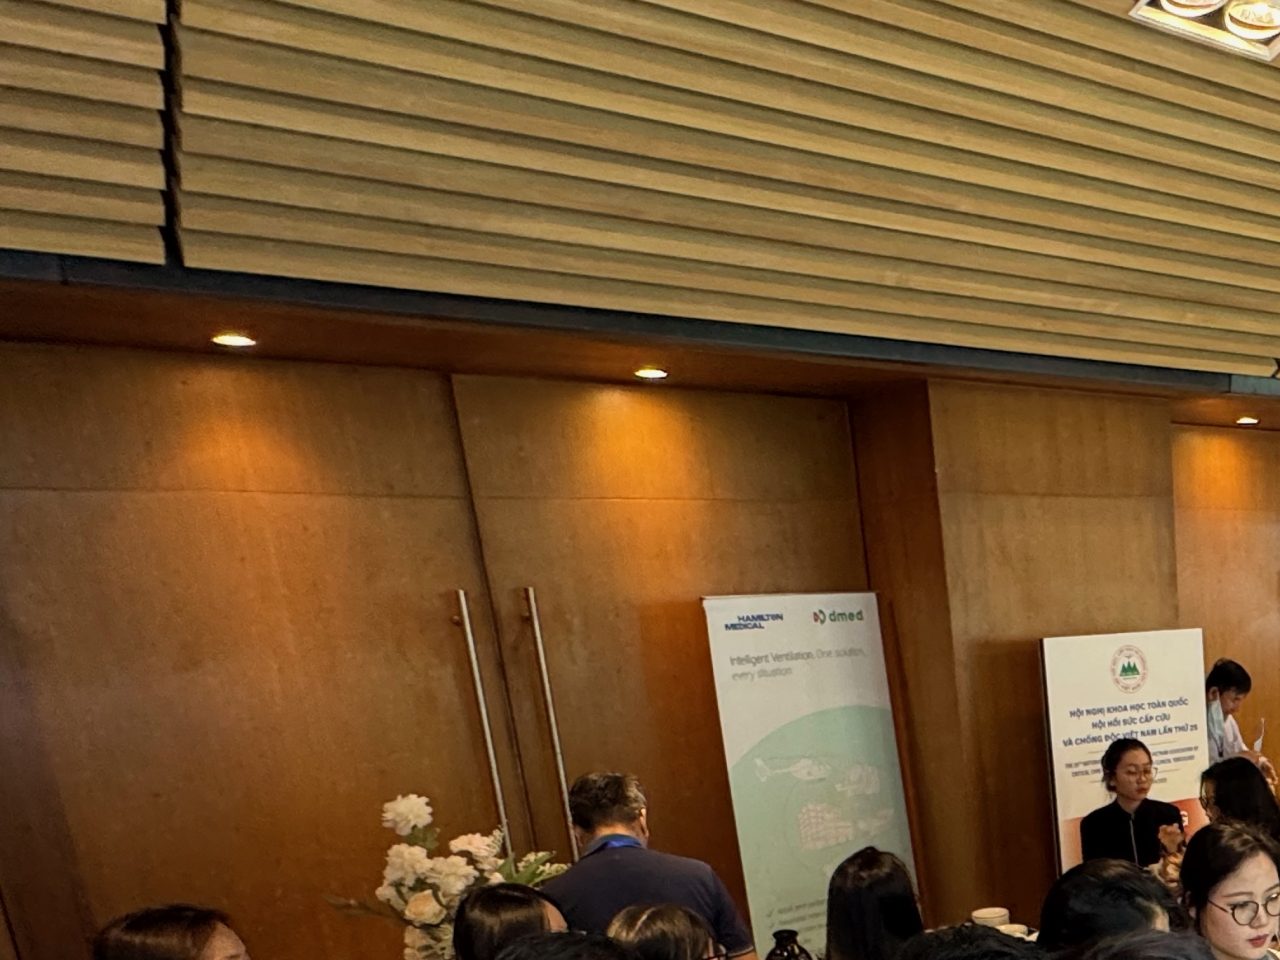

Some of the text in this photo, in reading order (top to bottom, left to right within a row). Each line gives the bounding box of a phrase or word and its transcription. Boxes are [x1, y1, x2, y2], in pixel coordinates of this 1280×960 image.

[737, 613, 783, 623] HAMILTON
[828, 609, 864, 623] dmed
[724, 622, 765, 631] MEDICAL
[1069, 697, 1189, 720] HỘI NGHỊ KHOA HỌC TOÀN QUỐC
[1091, 719, 1106, 731] HỘI
[1062, 736, 1074, 748] VÀ
[1074, 734, 1103, 746] CHỐNG
[1104, 731, 1120, 742] ĐỘC
[1140, 727, 1157, 738] NAM
